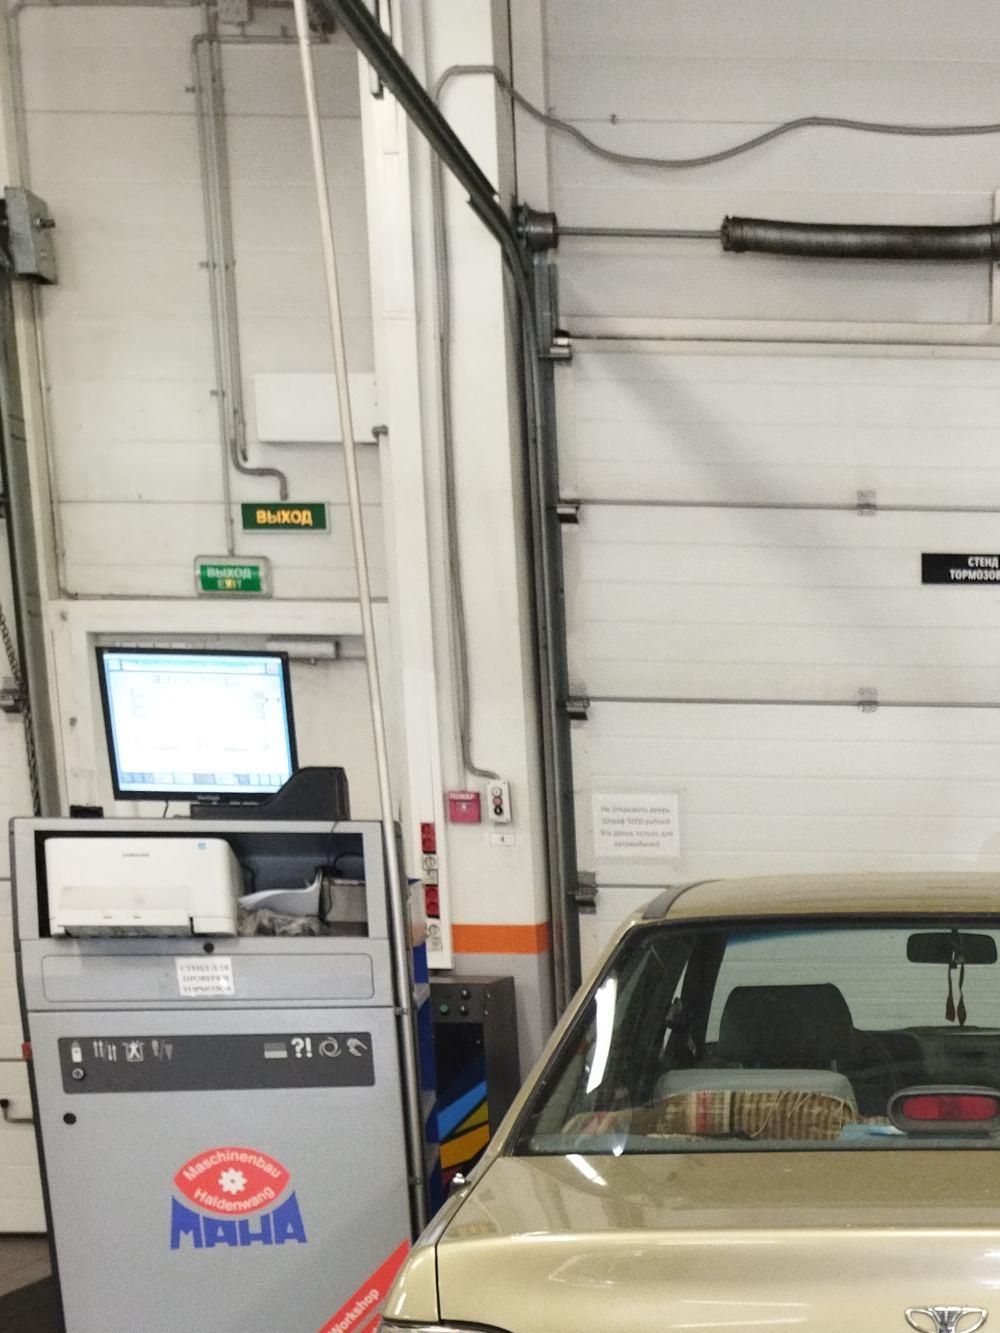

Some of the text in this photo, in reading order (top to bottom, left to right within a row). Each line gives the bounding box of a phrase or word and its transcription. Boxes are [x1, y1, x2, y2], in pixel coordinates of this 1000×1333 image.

[255, 508, 313, 526] ВЫХОД
[206, 567, 252, 580] ВЫХОД
[967, 556, 998, 569] СТЕНД
[182, 1149, 282, 1181] Maschinenbau
[193, 1186, 276, 1212] Haldenwang
[170, 1189, 308, 1250] MAHA
